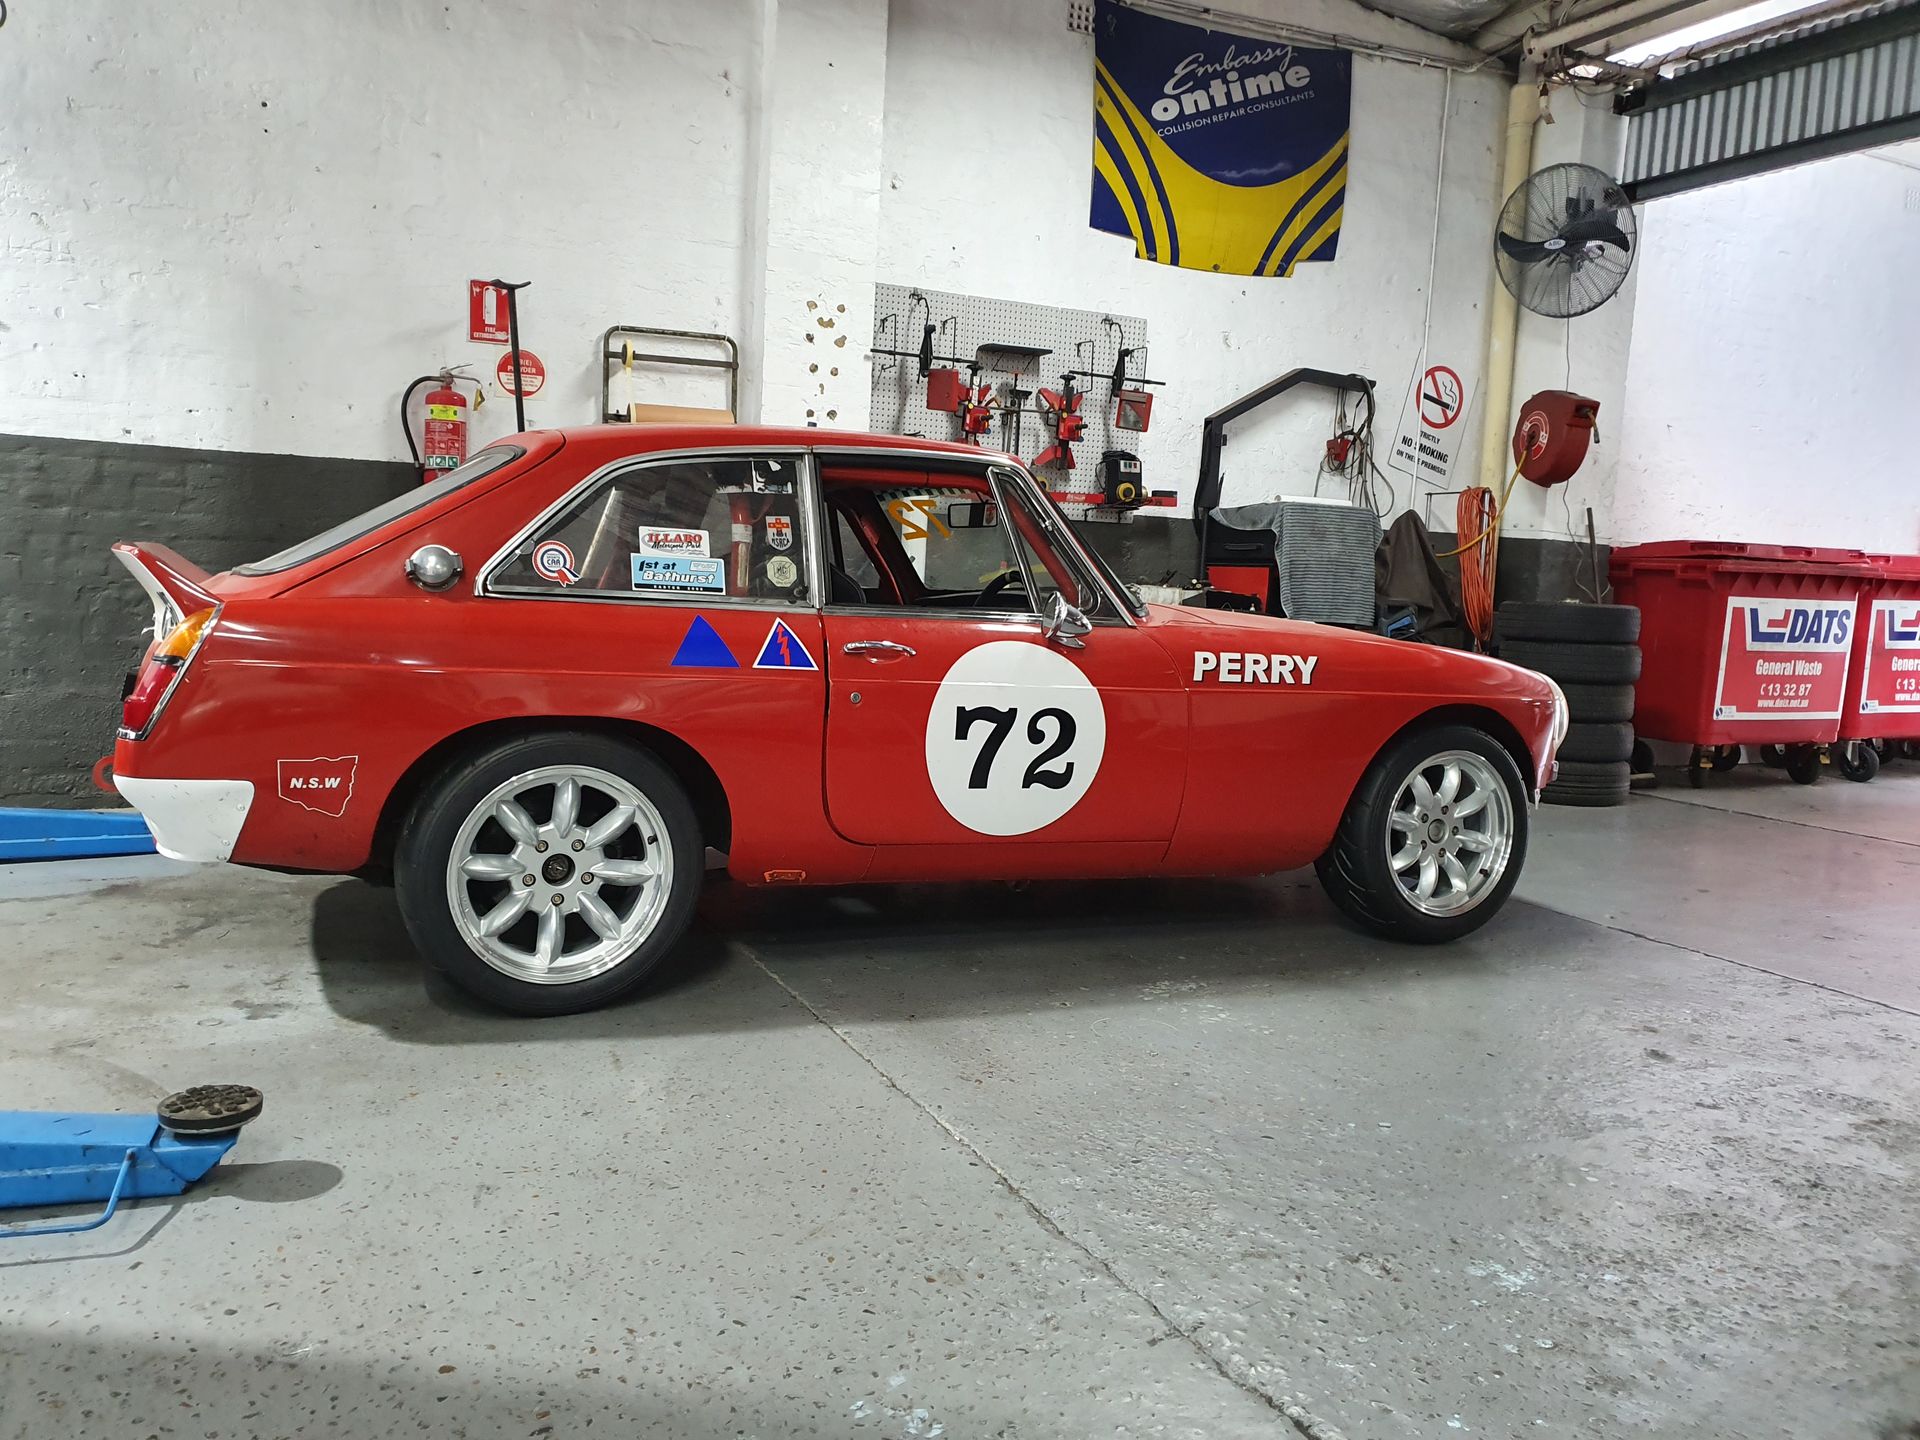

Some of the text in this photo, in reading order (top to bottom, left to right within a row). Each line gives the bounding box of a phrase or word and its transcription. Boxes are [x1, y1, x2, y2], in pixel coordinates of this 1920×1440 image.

[1163, 44, 1298, 95] Embassy
[1151, 66, 1311, 121] ontime
[1157, 90, 1316, 137] COLLISION REPAIR CONSULTANTS
[1401, 434, 1413, 448] NO
[1420, 430, 1441, 445] TRICTLY
[1396, 448, 1404, 458] ON
[1420, 459, 1447, 476] PREMISES
[647, 533, 703, 543] ILLABO
[638, 560, 677, 572] 1st at
[642, 569, 716, 584] Bathurst
[1787, 608, 1851, 645] DATS
[1192, 651, 1318, 685] PERRY
[1756, 659, 1823, 676] General Waste
[1767, 683, 1812, 696] 13 32 87
[1903, 678, 1916, 691] 13
[954, 705, 1077, 790] 72
[289, 777, 341, 789] N.S.W
